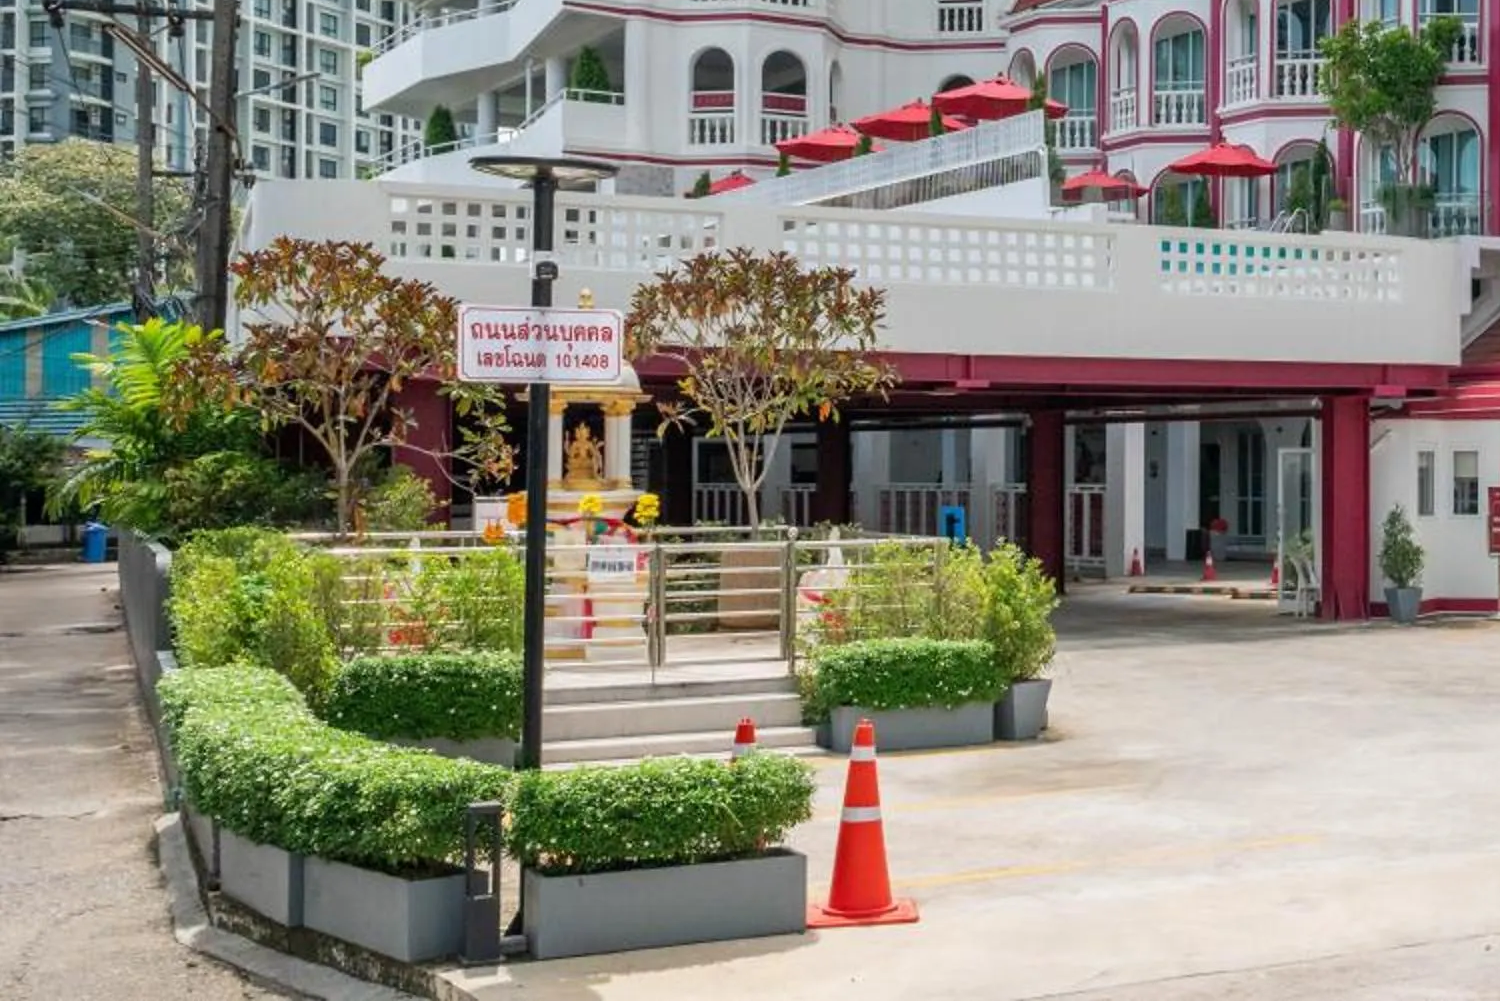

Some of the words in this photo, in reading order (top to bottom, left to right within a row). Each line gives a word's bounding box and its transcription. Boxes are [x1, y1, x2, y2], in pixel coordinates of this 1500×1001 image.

[470, 316, 613, 351] ถนนส่วนบุคคล
[555, 354, 609, 369] 101408
